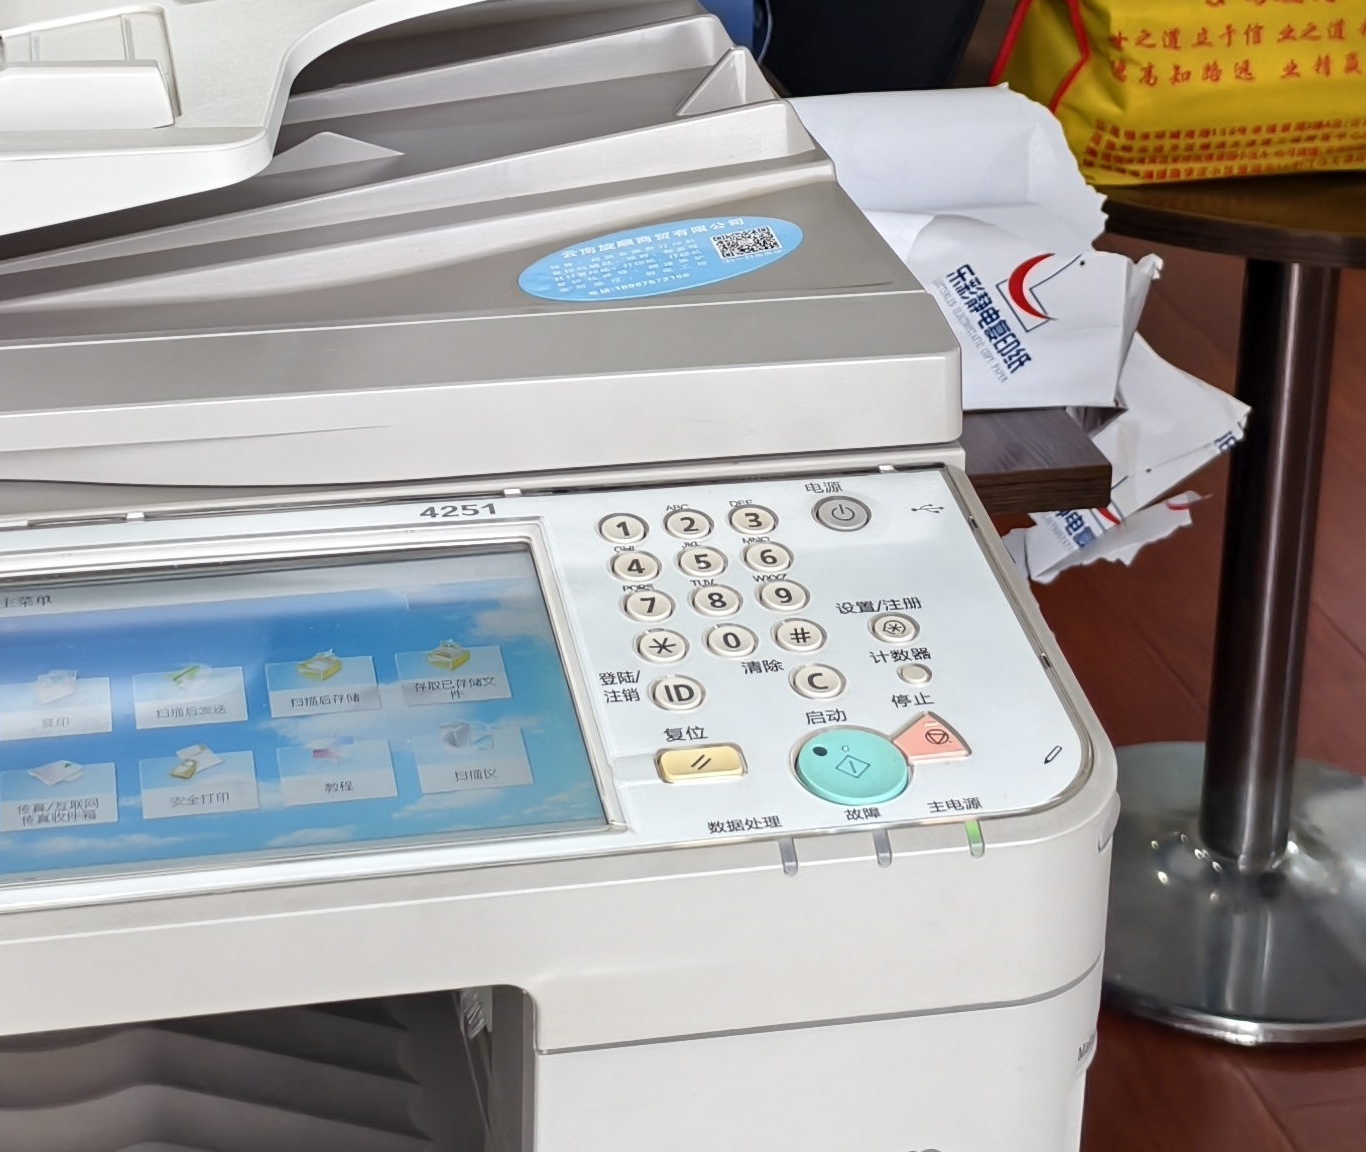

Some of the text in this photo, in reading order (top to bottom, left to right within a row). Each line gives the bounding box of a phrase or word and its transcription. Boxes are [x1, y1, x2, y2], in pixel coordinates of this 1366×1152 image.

[945, 263, 1033, 375] 乐彩静电复印纸
[804, 481, 844, 494] 电源
[419, 503, 498, 519] 4251
[680, 516, 700, 532] 2
[745, 512, 763, 528] 3
[616, 521, 631, 537] 1
[694, 553, 712, 570] 5
[760, 549, 777, 565] 6
[627, 558, 646, 574] 4
[707, 592, 727, 608] 8
[774, 587, 793, 604] 9
[639, 597, 656, 614] 7
[835, 596, 922, 615] 设置/注册
[722, 632, 741, 649] 0
[869, 647, 932, 664] 计数器
[741, 659, 785, 675] 清除
[598, 669, 640, 686] 登陆/
[807, 672, 829, 690] C
[290, 694, 361, 708] 扫描后存储
[603, 687, 640, 704] 注销
[663, 682, 695, 703] ID
[891, 691, 934, 709] 停止
[805, 708, 848, 725] 启动
[663, 725, 708, 742] 复位
[170, 791, 231, 808] 安全打印
[927, 796, 983, 814] 主电源
[844, 807, 882, 822] 故障
[707, 814, 783, 835] 数据处理
